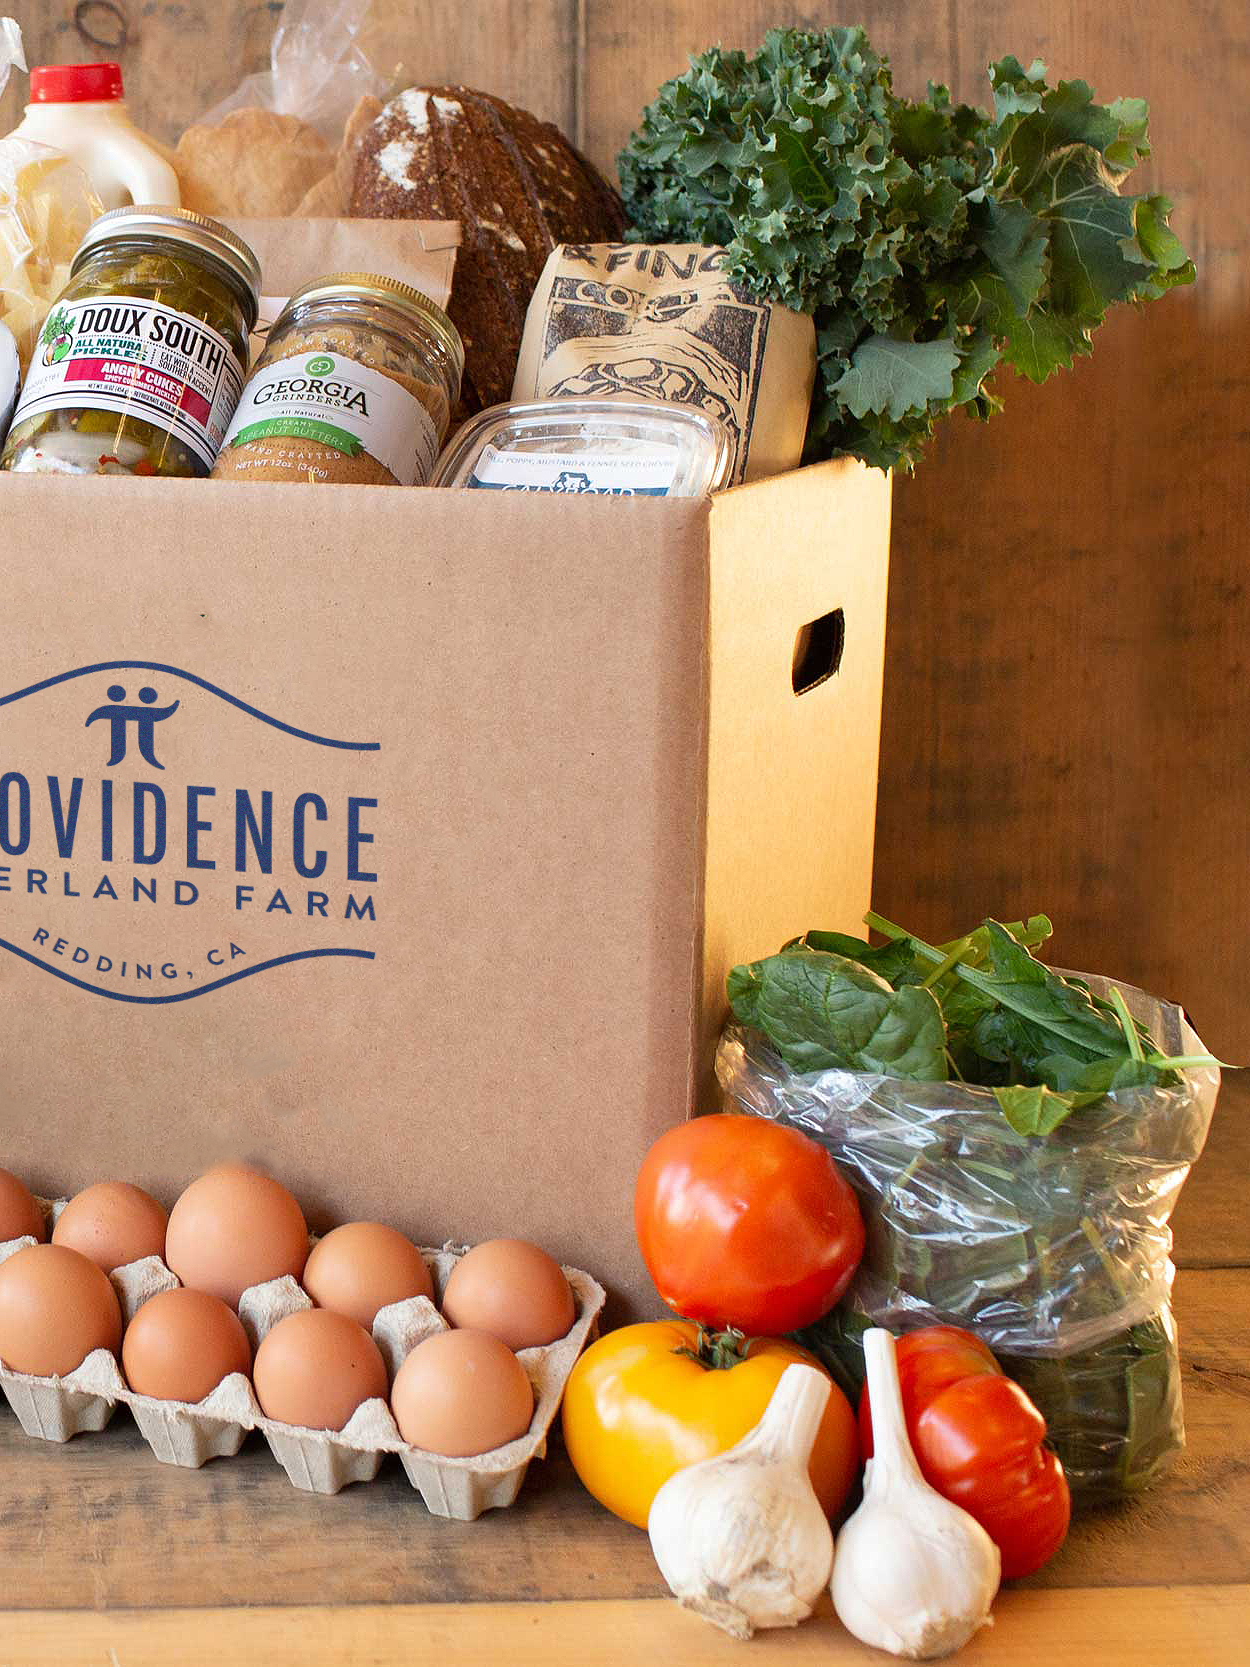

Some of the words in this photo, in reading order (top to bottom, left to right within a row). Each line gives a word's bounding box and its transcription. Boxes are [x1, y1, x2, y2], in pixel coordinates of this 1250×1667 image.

[75, 339, 94, 348] ALL
[78, 308, 147, 337] DOUX
[149, 315, 223, 376] SOUTH
[72, 347, 148, 361] PICKLES
[160, 351, 174, 362] EAT
[173, 356, 190, 371] WITH
[101, 362, 145, 379] ANGRY
[145, 372, 183, 396] CUKES
[158, 360, 191, 379] SOUTHERN
[103, 374, 123, 384] SPICY
[154, 385, 178, 403] PICKLES
[191, 376, 212, 397] ACCENT
[253, 378, 370, 417] GEORGIA
[272, 391, 341, 407] GRINDERS
[276, 419, 314, 427] CREAMY
[294, 409, 325, 419] Natural
[246, 426, 290, 441] PEANUT
[294, 426, 339, 446] BUTTER
[244, 443, 272, 455] HAND
[278, 449, 341, 460] CRAFTED
[235, 461, 253, 472] NET
[253, 459, 269, 467] WT
[270, 459, 294, 468] 12oz.
[297, 462, 328, 479] (340g)
[235, 885, 377, 922] FARM
[32, 927, 194, 980] REDDING,
[206, 941, 247, 966] CA
